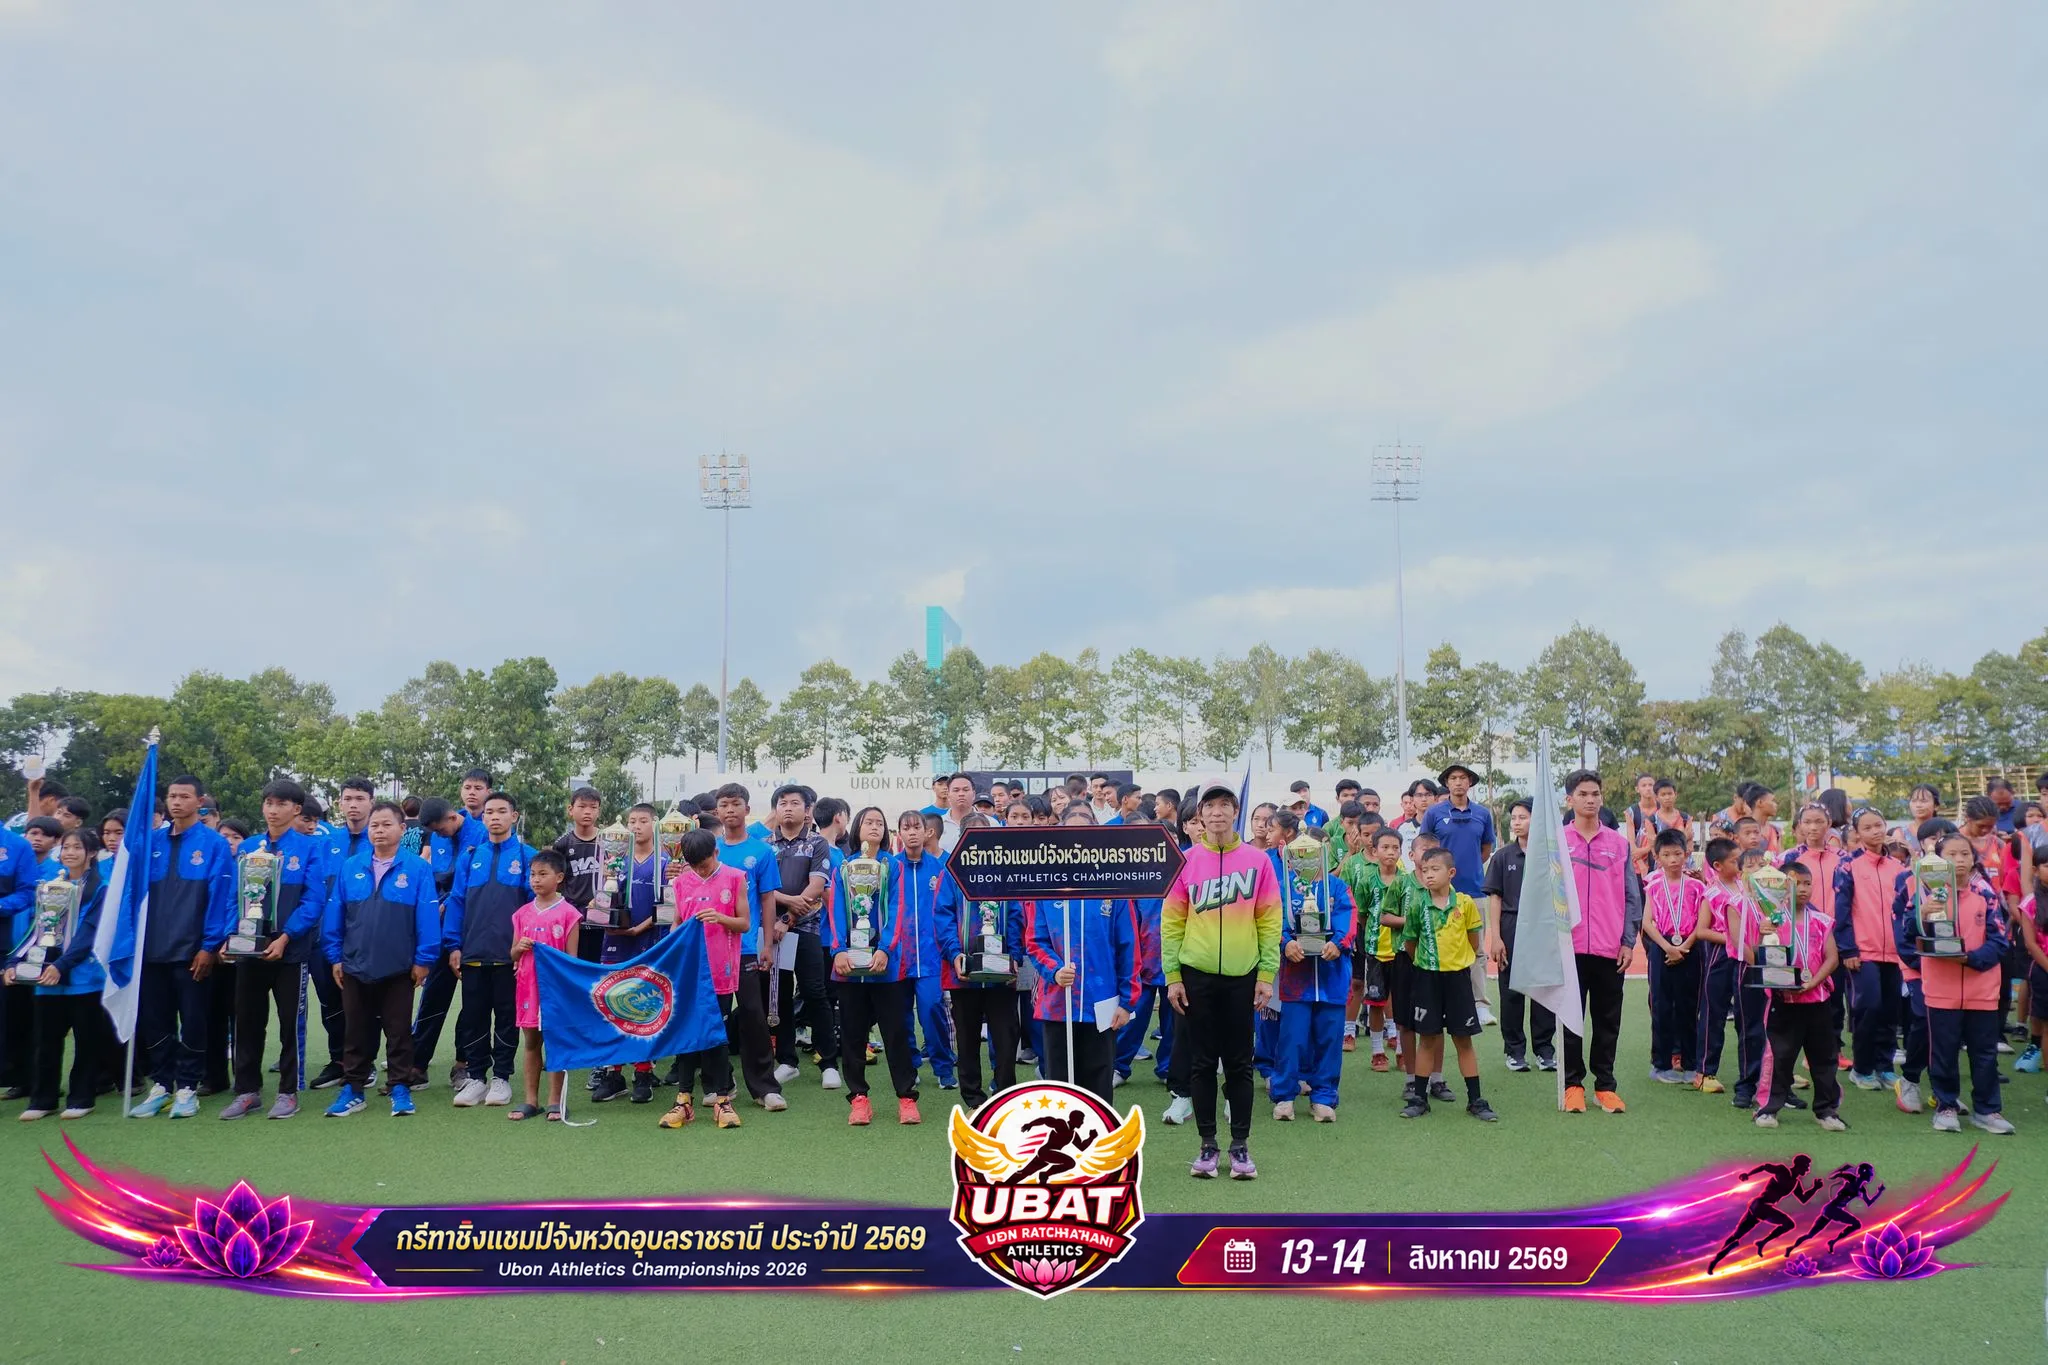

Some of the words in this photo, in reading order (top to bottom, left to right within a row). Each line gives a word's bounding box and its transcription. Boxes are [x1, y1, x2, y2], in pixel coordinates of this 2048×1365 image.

[851, 776, 890, 790] UBON
[969, 874, 1002, 883] UBON
[1006, 873, 1068, 883] ATHLETICS
[1073, 871, 1162, 881] CHAMPIONSHIPS
[1188, 868, 1257, 914] UBN
